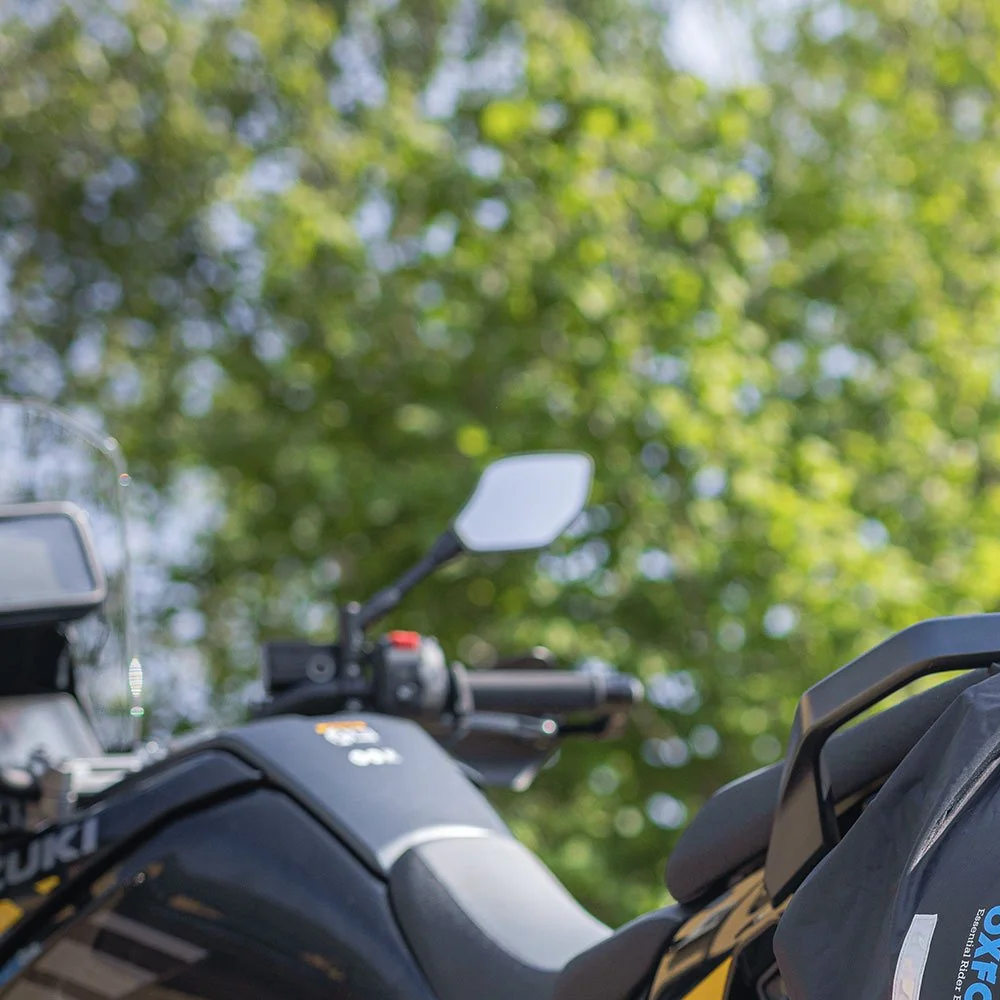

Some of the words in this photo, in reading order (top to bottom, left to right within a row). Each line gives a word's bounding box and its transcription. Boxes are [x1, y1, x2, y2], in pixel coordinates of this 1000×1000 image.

[0, 818, 98, 888] UKI
[963, 908, 986, 958] Essential
[954, 960, 970, 992] Rider
